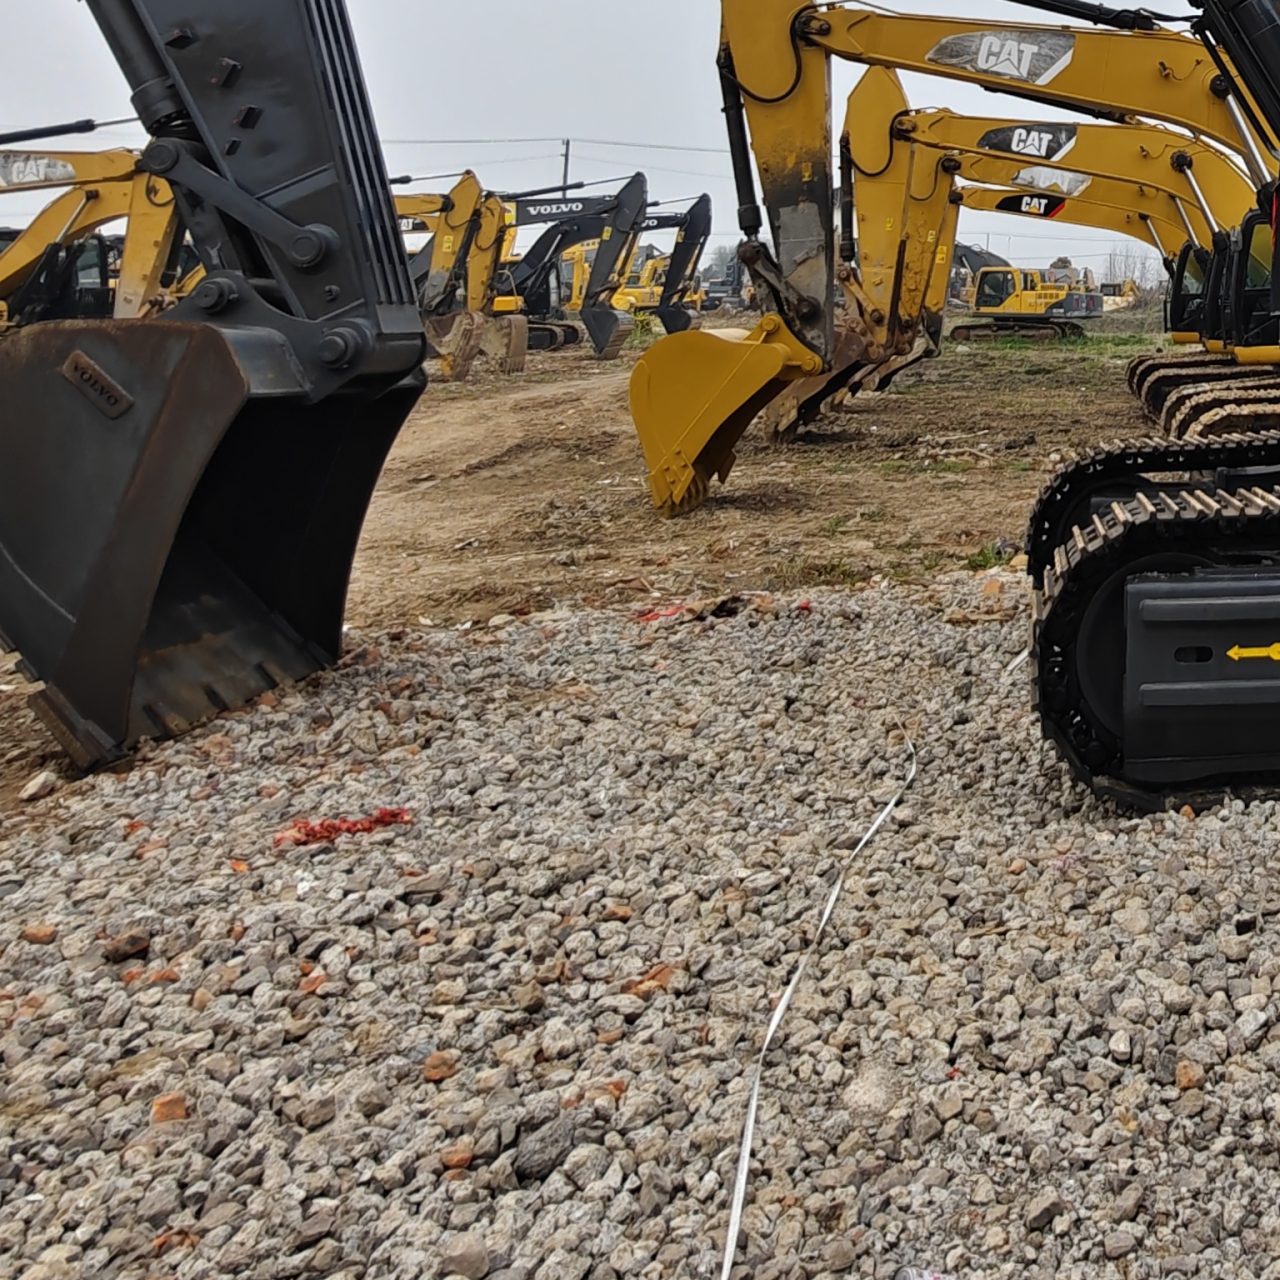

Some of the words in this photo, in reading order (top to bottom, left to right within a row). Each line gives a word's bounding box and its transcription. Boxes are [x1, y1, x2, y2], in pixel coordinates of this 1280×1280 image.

[977, 36, 1038, 78] CAT
[1011, 128, 1053, 157] CAT
[12, 157, 48, 182] CAT
[526, 202, 583, 216] VOLVO
[1020, 196, 1048, 214] CAT
[399, 218, 413, 231] AT
[73, 362, 118, 407] VOLVO
